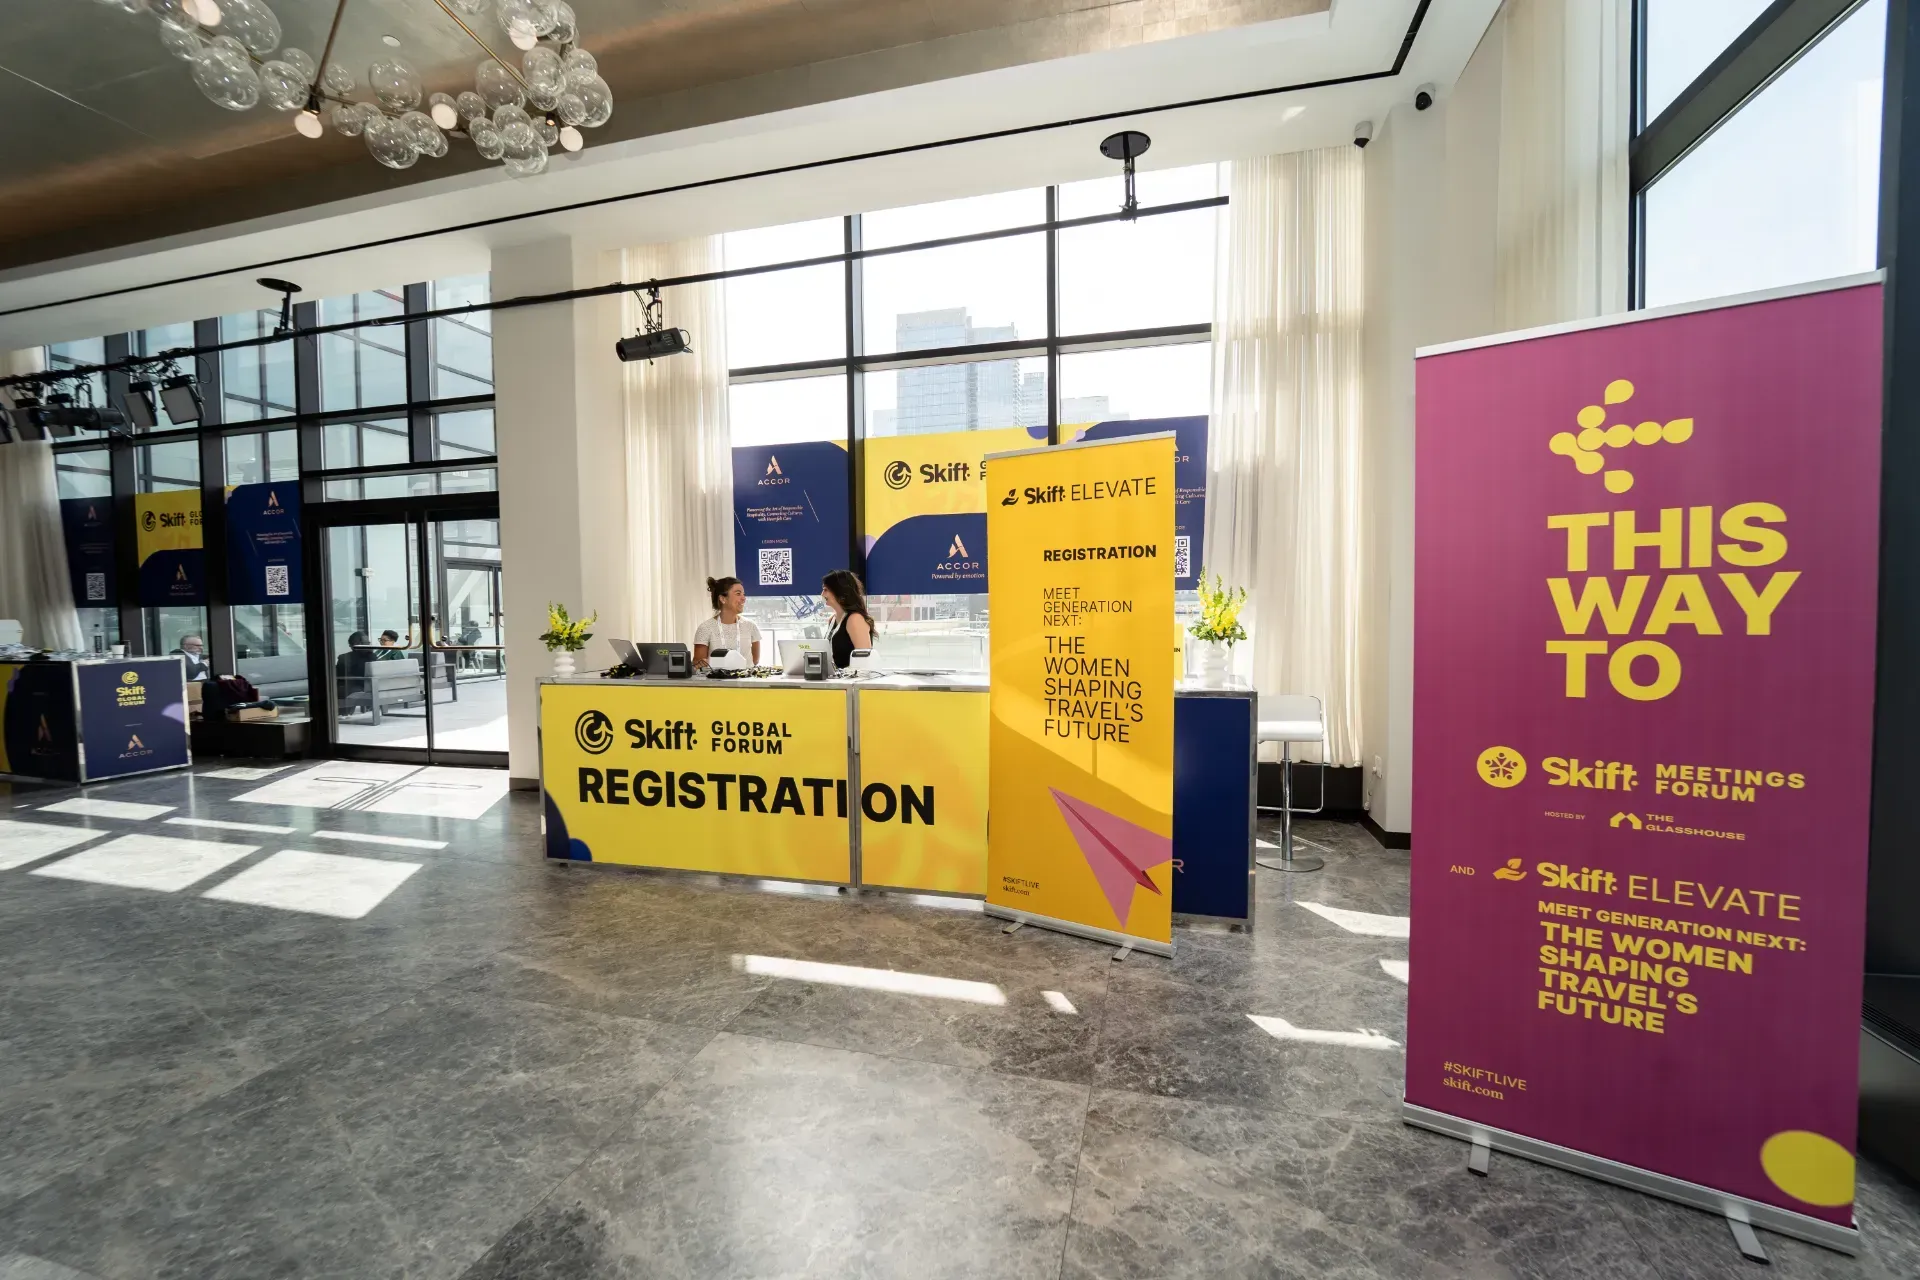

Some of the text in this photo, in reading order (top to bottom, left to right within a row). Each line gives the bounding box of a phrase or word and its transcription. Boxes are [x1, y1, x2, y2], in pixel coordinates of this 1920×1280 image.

[758, 478, 790, 486] ACCOR
[920, 462, 970, 483] Skift
[1024, 477, 1157, 505] Skift ELEVATE
[160, 512, 186, 527] Skift
[1547, 501, 1788, 572] THIS
[1044, 545, 1157, 561] REGISTRATION
[932, 572, 954, 580] Powered
[955, 572, 961, 580] by
[937, 562, 979, 570] ACCOR
[1043, 587, 1080, 599] MEET
[1546, 571, 1802, 635] WAY
[1043, 600, 1132, 613] GENERATION
[1043, 614, 1082, 626] NEXT:
[1044, 635, 1085, 654] THE
[1044, 656, 1130, 677] WOMEN
[1546, 640, 1682, 701] TO
[116, 685, 146, 697] Skift
[1044, 677, 1142, 700] SHAPING
[1044, 698, 1144, 722] TRAVEL'S
[624, 718, 698, 750] Skift
[711, 720, 792, 738] GLOBAL
[1044, 719, 1130, 743] FUTURE
[118, 750, 153, 758] ACCOR
[711, 738, 783, 755] FORUM
[1541, 756, 1639, 791] Skift
[1655, 763, 1805, 789] MEETINGS
[578, 767, 935, 826] REGISTRATION
[1655, 780, 1756, 802] FORUM
[1544, 810, 1574, 819] HOSTED
[1646, 813, 1674, 823] THE
[1646, 824, 1746, 841] GLASSHOUSE
[1450, 865, 1475, 876] AND
[1002, 875, 1040, 890] #SKIFTLIVE
[1002, 884, 1030, 896] skift.com
[1536, 861, 1801, 921] Skift ELEVATE
[1538, 900, 1807, 952] MEET GENERATION NEXT:
[1540, 920, 1753, 975] THE WOMEN
[1539, 944, 1689, 988] SHAPING
[1538, 966, 1699, 1015] TRAVEL'S
[1538, 989, 1665, 1034] FUTURE
[1443, 1060, 1527, 1091] #SKIFTLIVE
[1442, 1076, 1504, 1100] skift.com
